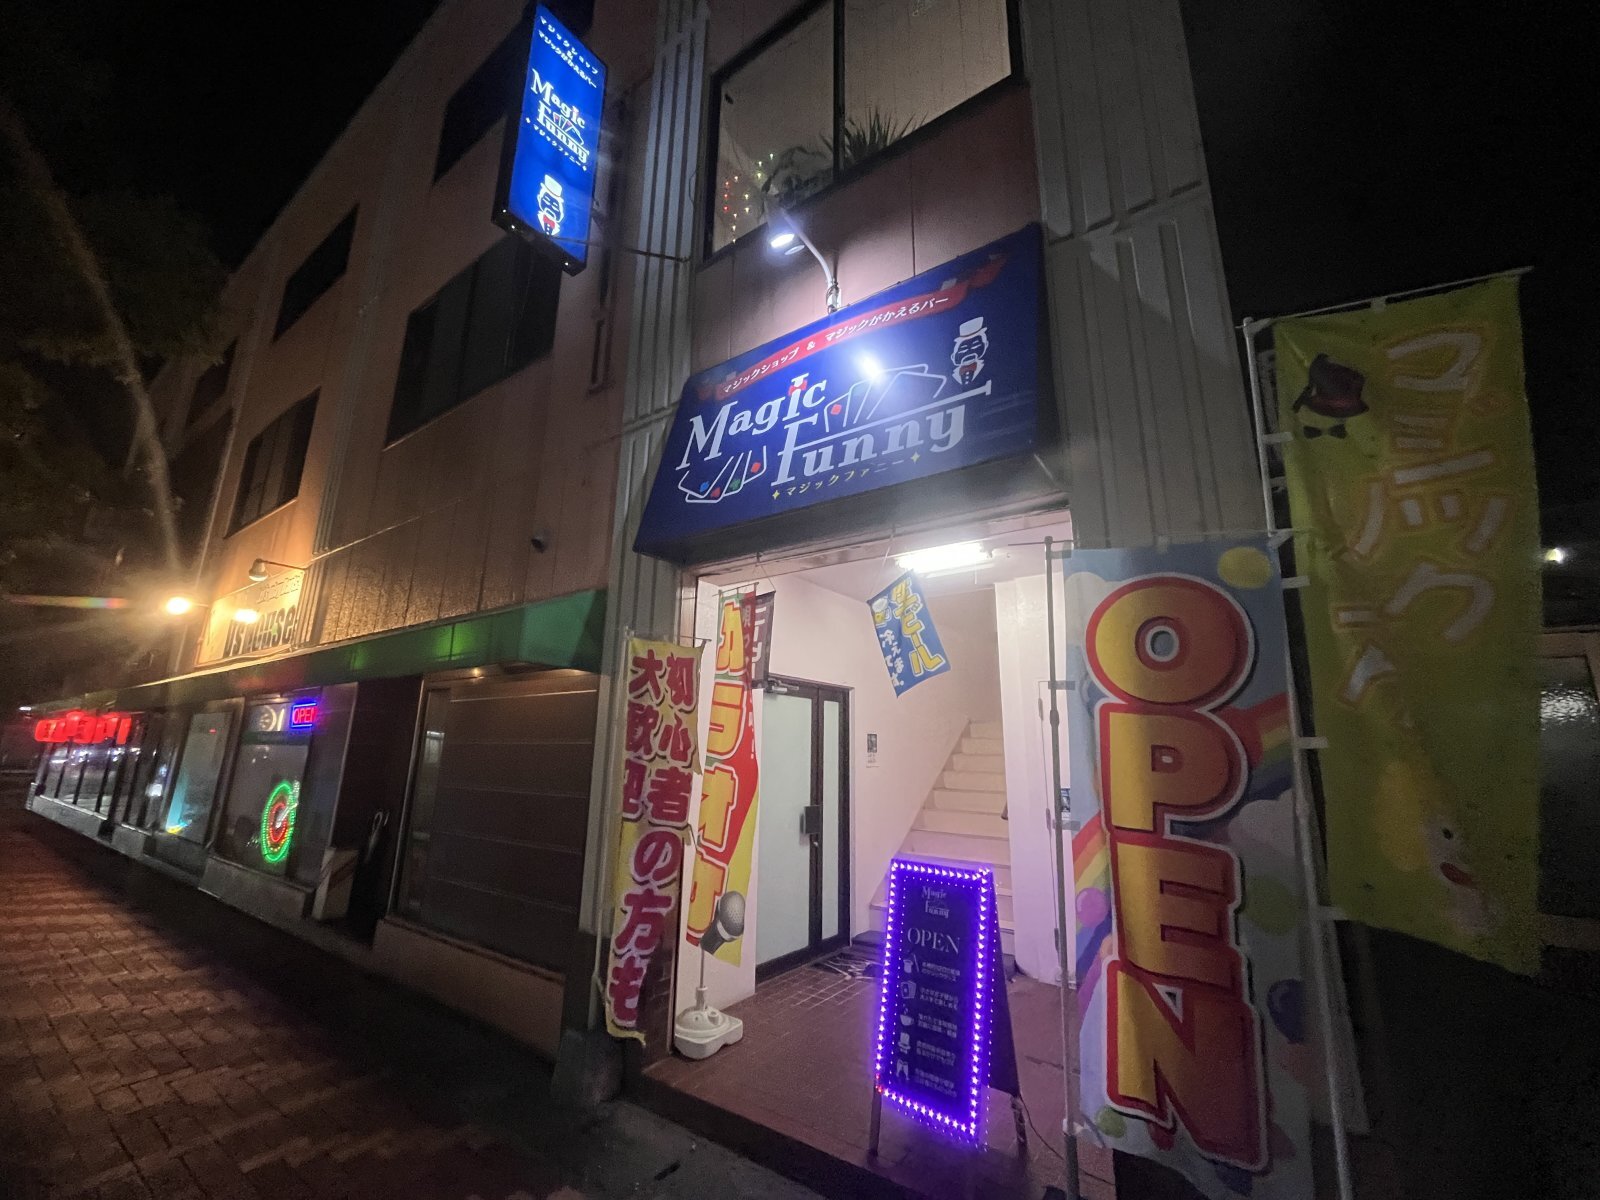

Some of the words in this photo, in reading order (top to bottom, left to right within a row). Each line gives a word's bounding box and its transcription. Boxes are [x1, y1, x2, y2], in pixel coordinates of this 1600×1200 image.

[530, 68, 586, 129] Magic
[536, 100, 590, 164] Funny
[724, 346, 801, 393] マジックショップ
[806, 340, 817, 352] &
[825, 297, 950, 342] マジックがかえるバー
[675, 373, 828, 470] Magic
[771, 380, 992, 488] Funny
[786, 459, 905, 497] マジックファニー
[891, 577, 946, 678] 生ビール
[921, 885, 947, 900] Magic
[1084, 573, 1269, 1171] OPEN
[907, 927, 961, 955] OPEN
